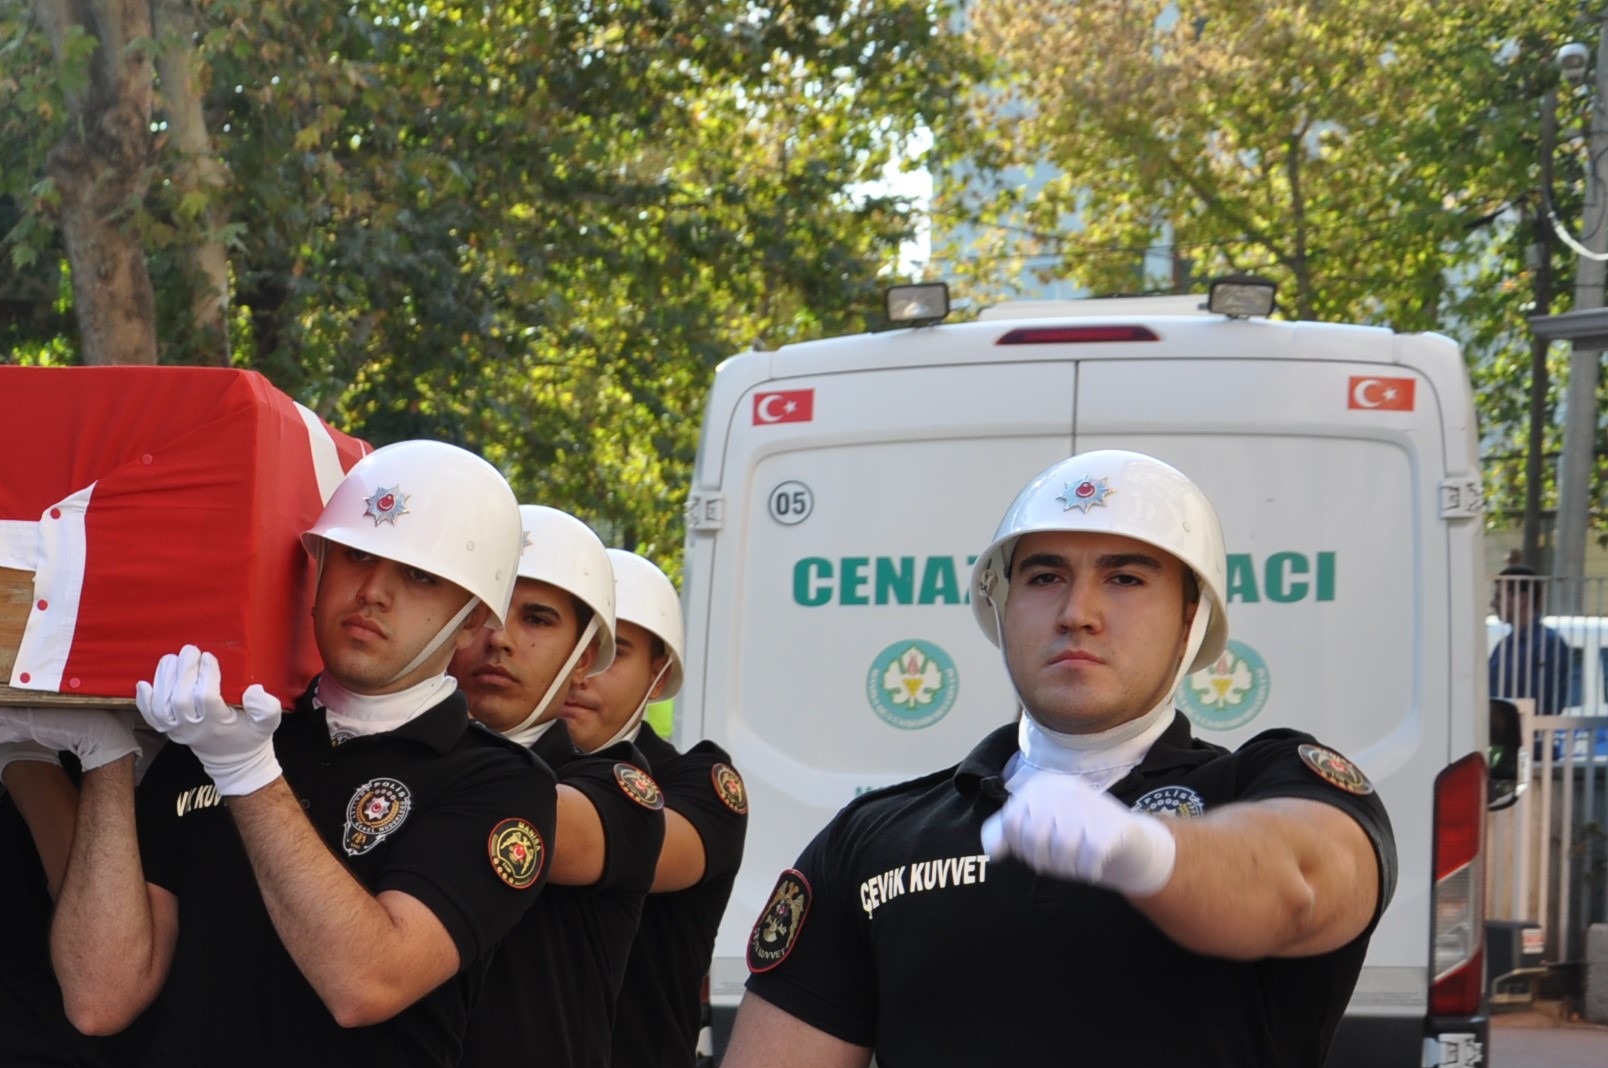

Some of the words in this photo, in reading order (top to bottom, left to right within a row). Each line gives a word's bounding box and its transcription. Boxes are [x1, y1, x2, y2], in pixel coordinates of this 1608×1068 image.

[776, 491, 806, 516] 05
[1226, 550, 1336, 603] ACI
[860, 866, 906, 919] ÇEVİK
[909, 855, 990, 893] KUVVET
